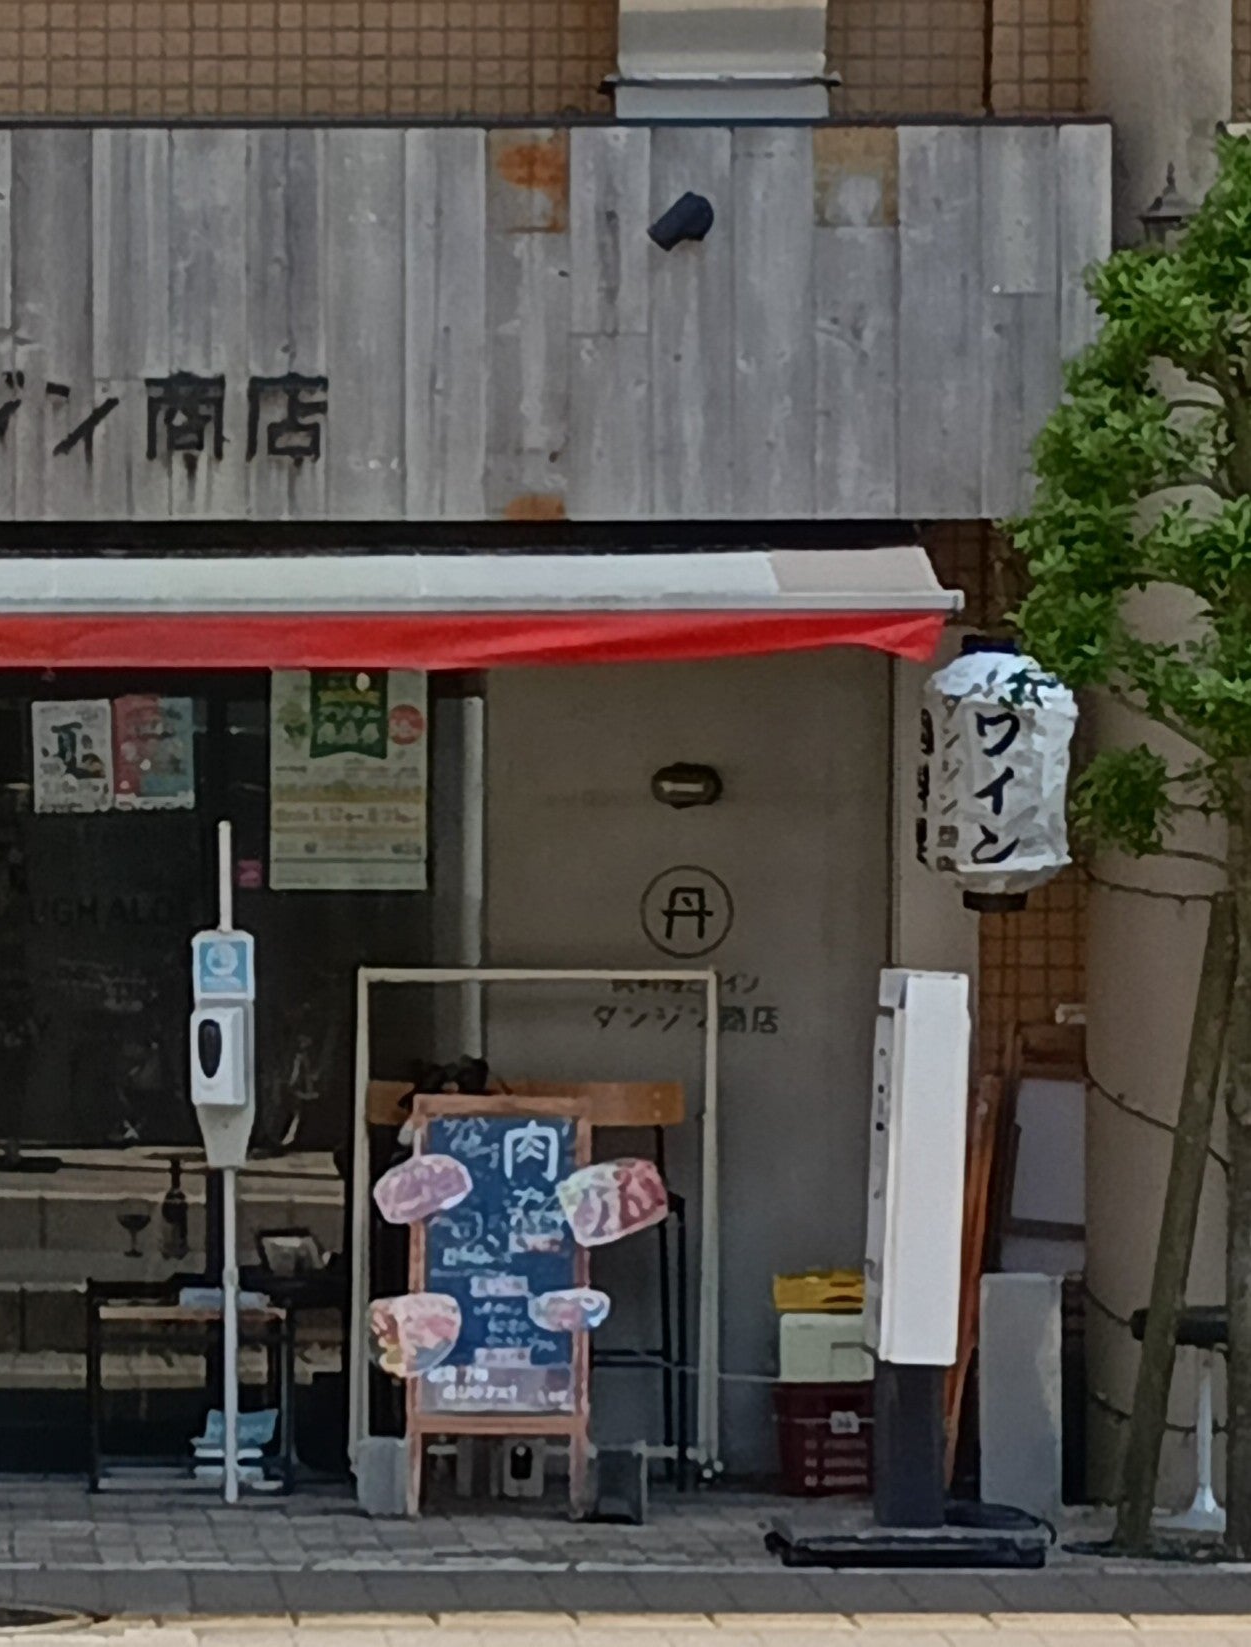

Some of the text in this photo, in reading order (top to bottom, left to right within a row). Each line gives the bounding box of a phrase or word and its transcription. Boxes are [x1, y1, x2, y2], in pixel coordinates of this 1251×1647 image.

[970, 711, 1021, 864] ワイン
[503, 1119, 560, 1182] 肉
